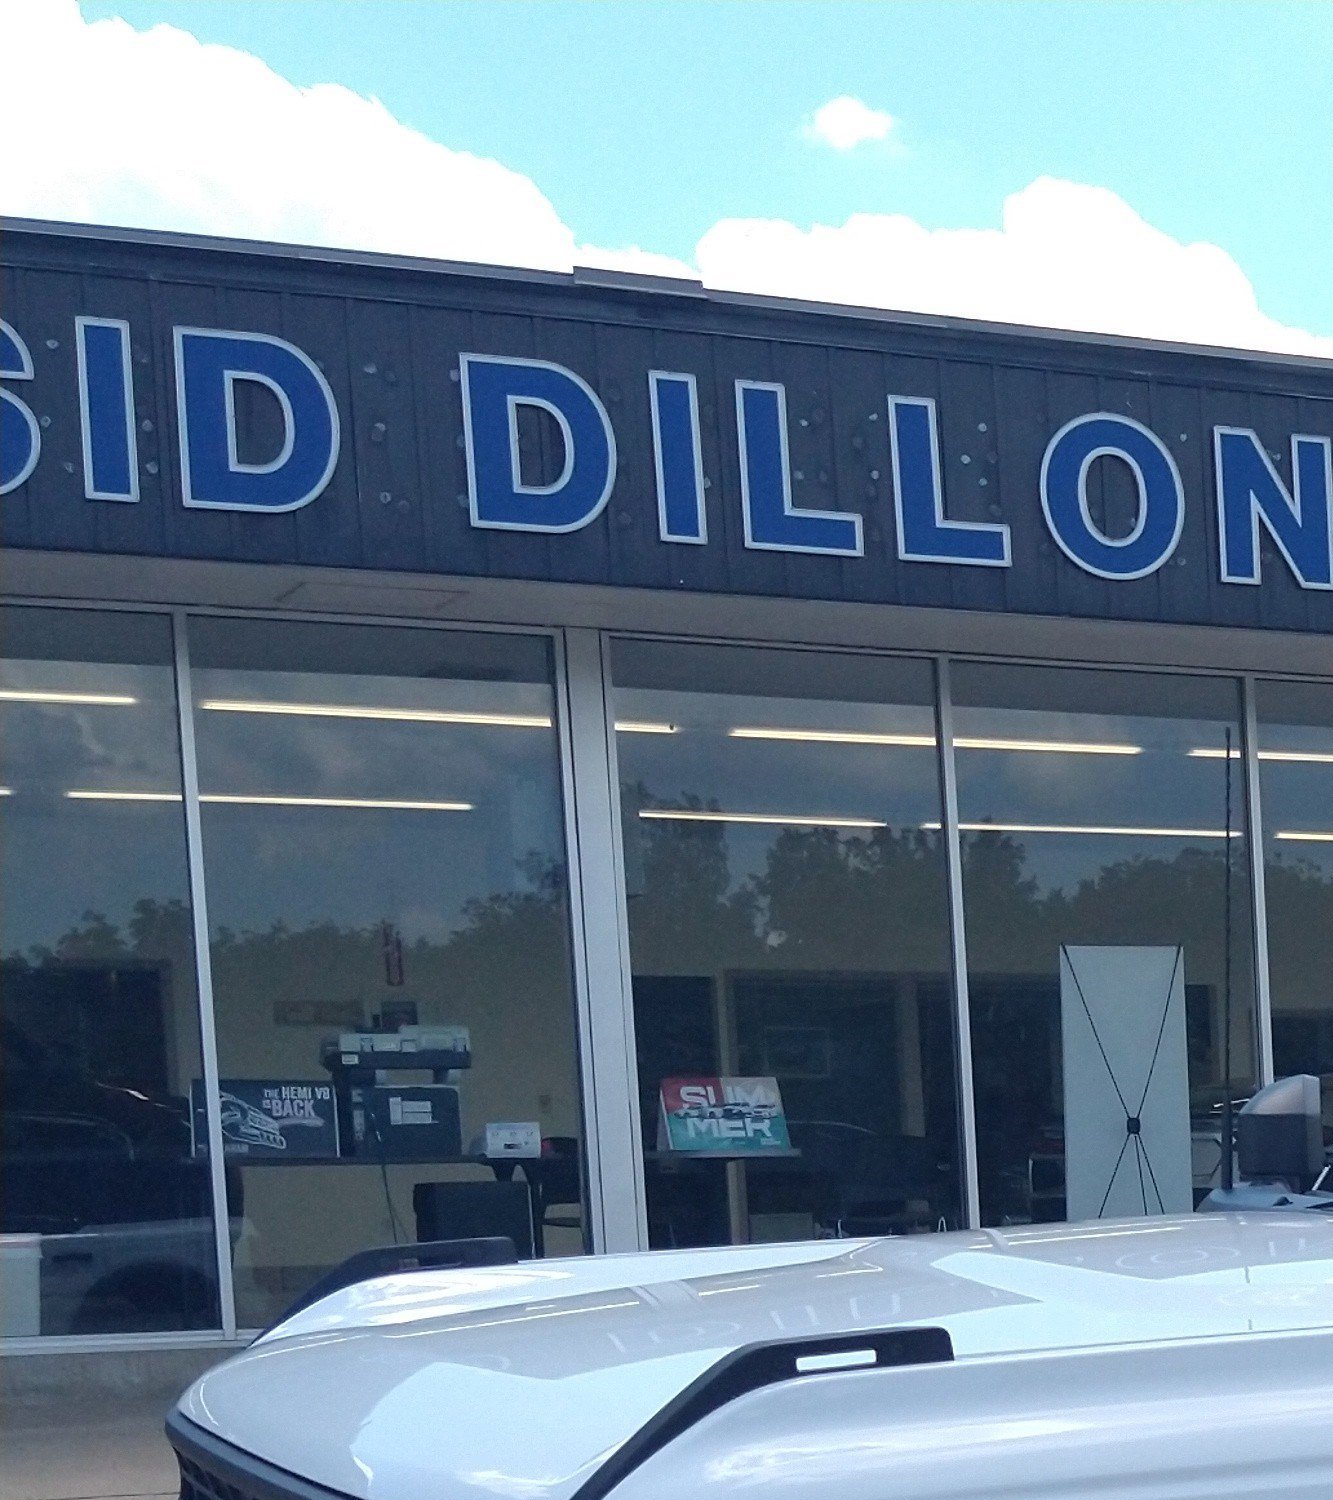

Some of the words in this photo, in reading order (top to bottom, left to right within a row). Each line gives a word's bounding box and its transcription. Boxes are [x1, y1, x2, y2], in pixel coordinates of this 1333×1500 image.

[282, 1086, 312, 1099] HEMI
[315, 1086, 330, 1099] V8
[271, 1100, 315, 1117] BACK
[686, 1117, 773, 1138] MER
